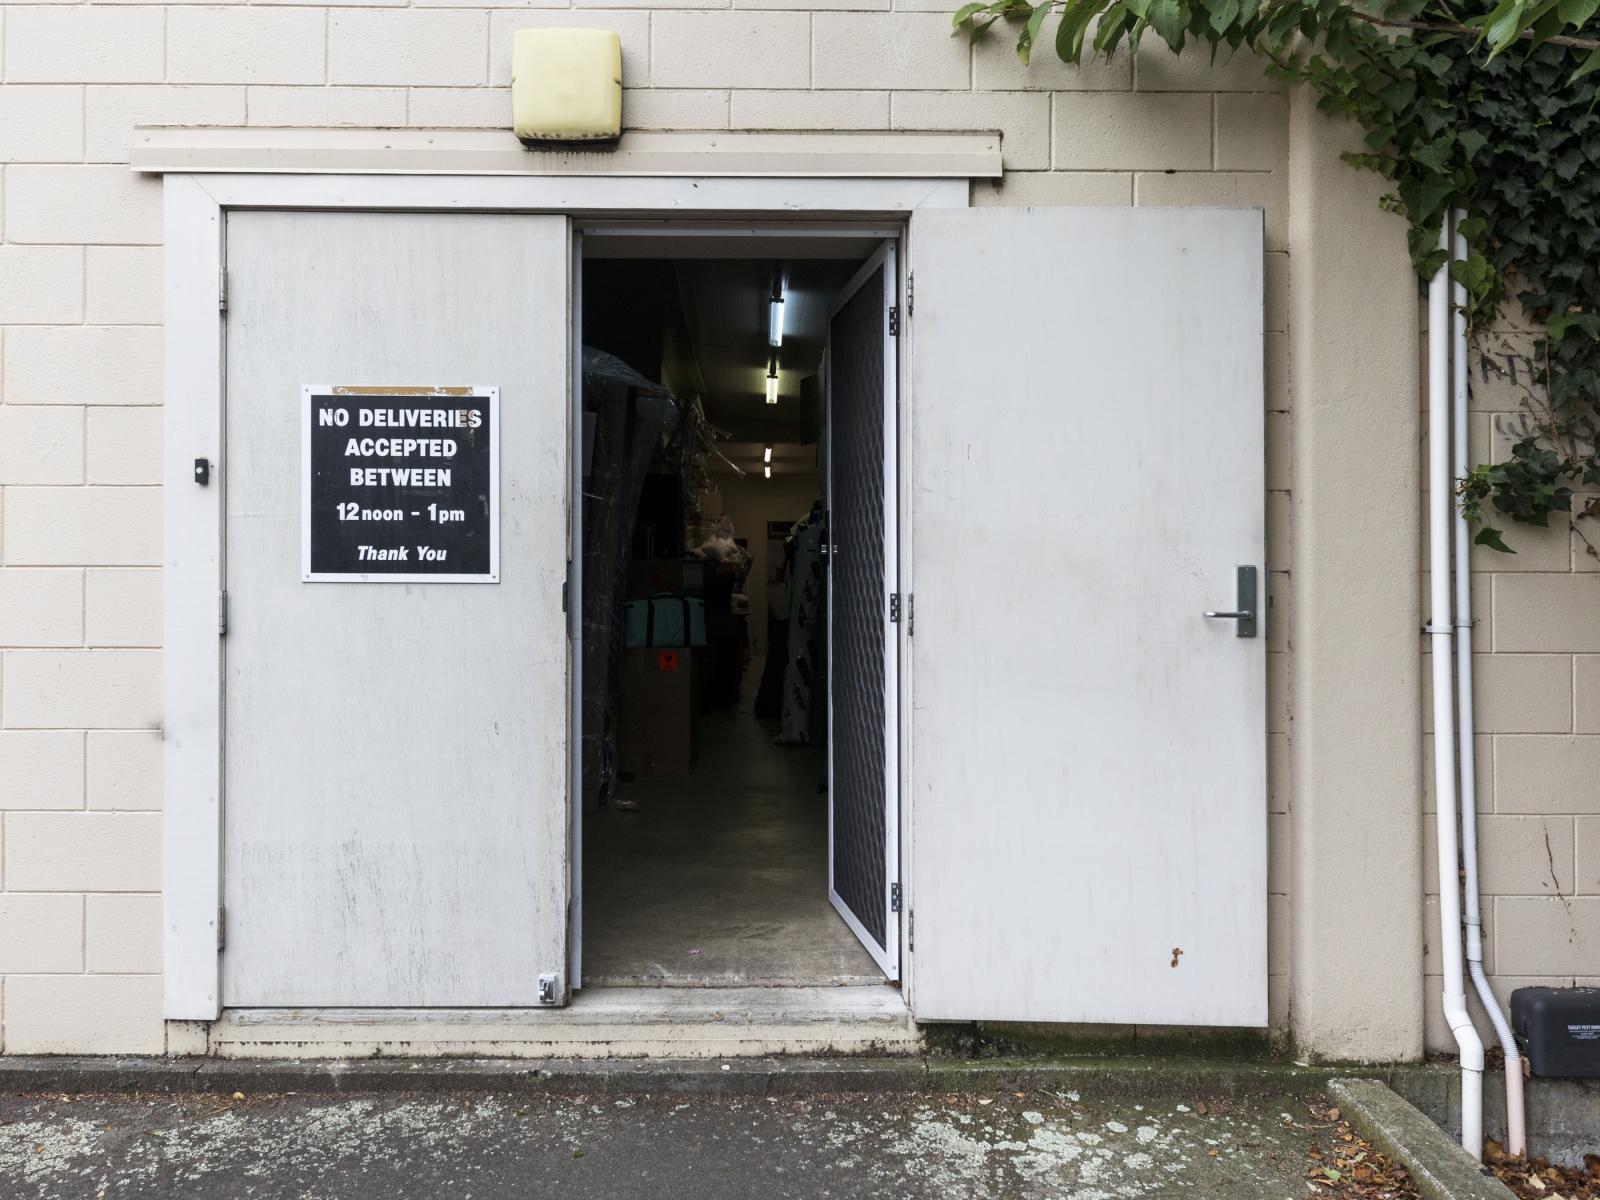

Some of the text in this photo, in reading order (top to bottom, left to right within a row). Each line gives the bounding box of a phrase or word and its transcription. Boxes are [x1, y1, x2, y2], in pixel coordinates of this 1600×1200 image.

[319, 408, 482, 428] NO DELIVERIES
[344, 438, 458, 457] ACCEPTED
[350, 468, 452, 487] BETWEEN
[357, 545, 448, 561] Thank You
